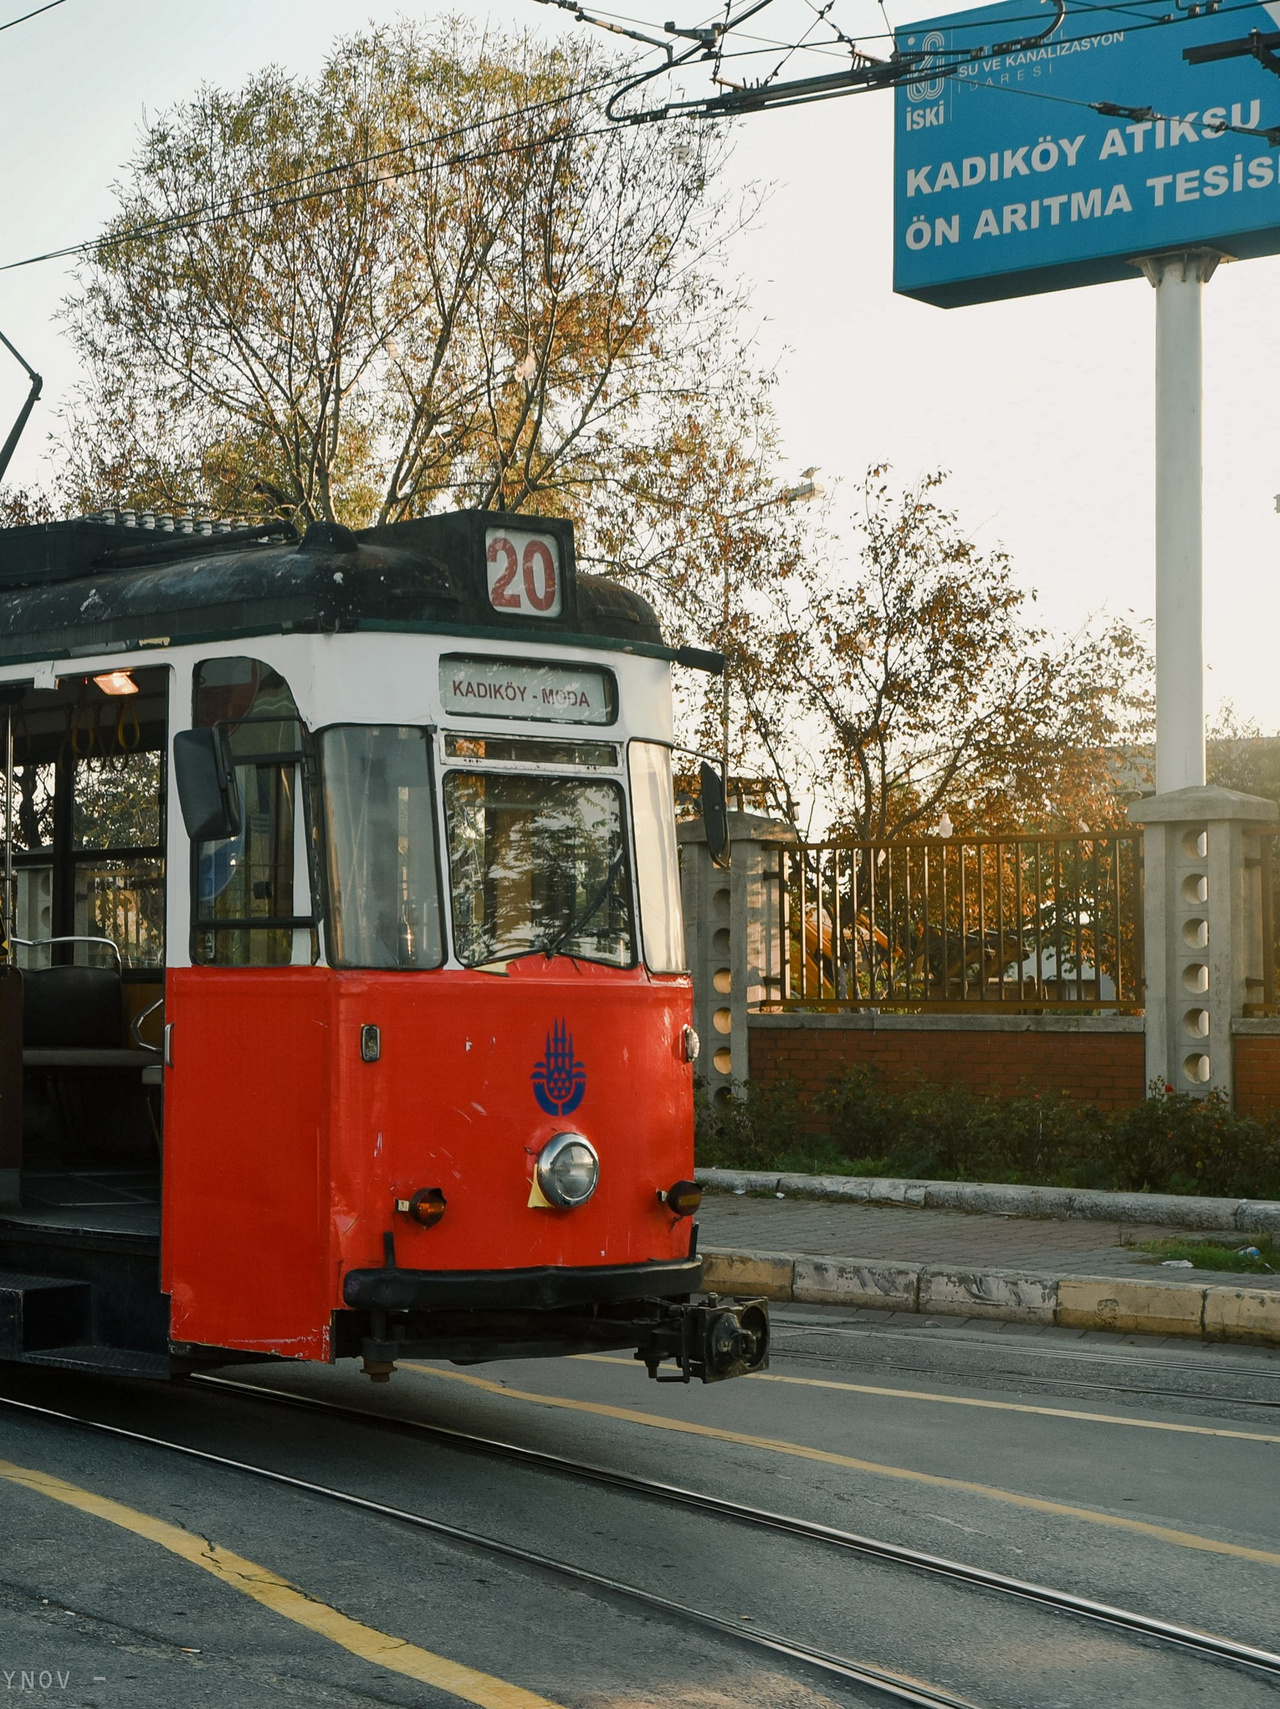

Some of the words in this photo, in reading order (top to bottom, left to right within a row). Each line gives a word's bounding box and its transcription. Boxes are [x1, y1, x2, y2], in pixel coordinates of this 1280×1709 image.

[959, 63, 978, 78] SU
[982, 57, 1001, 72] VE
[906, 134, 1086, 197] KADIKÖY
[1098, 98, 1260, 160] ATIKSU
[905, 214, 960, 250] ÖN
[973, 184, 1132, 239] ARITMA
[1146, 153, 1280, 207] TESİS
[486, 537, 556, 611] 20
[452, 680, 527, 703] KADIKÖY
